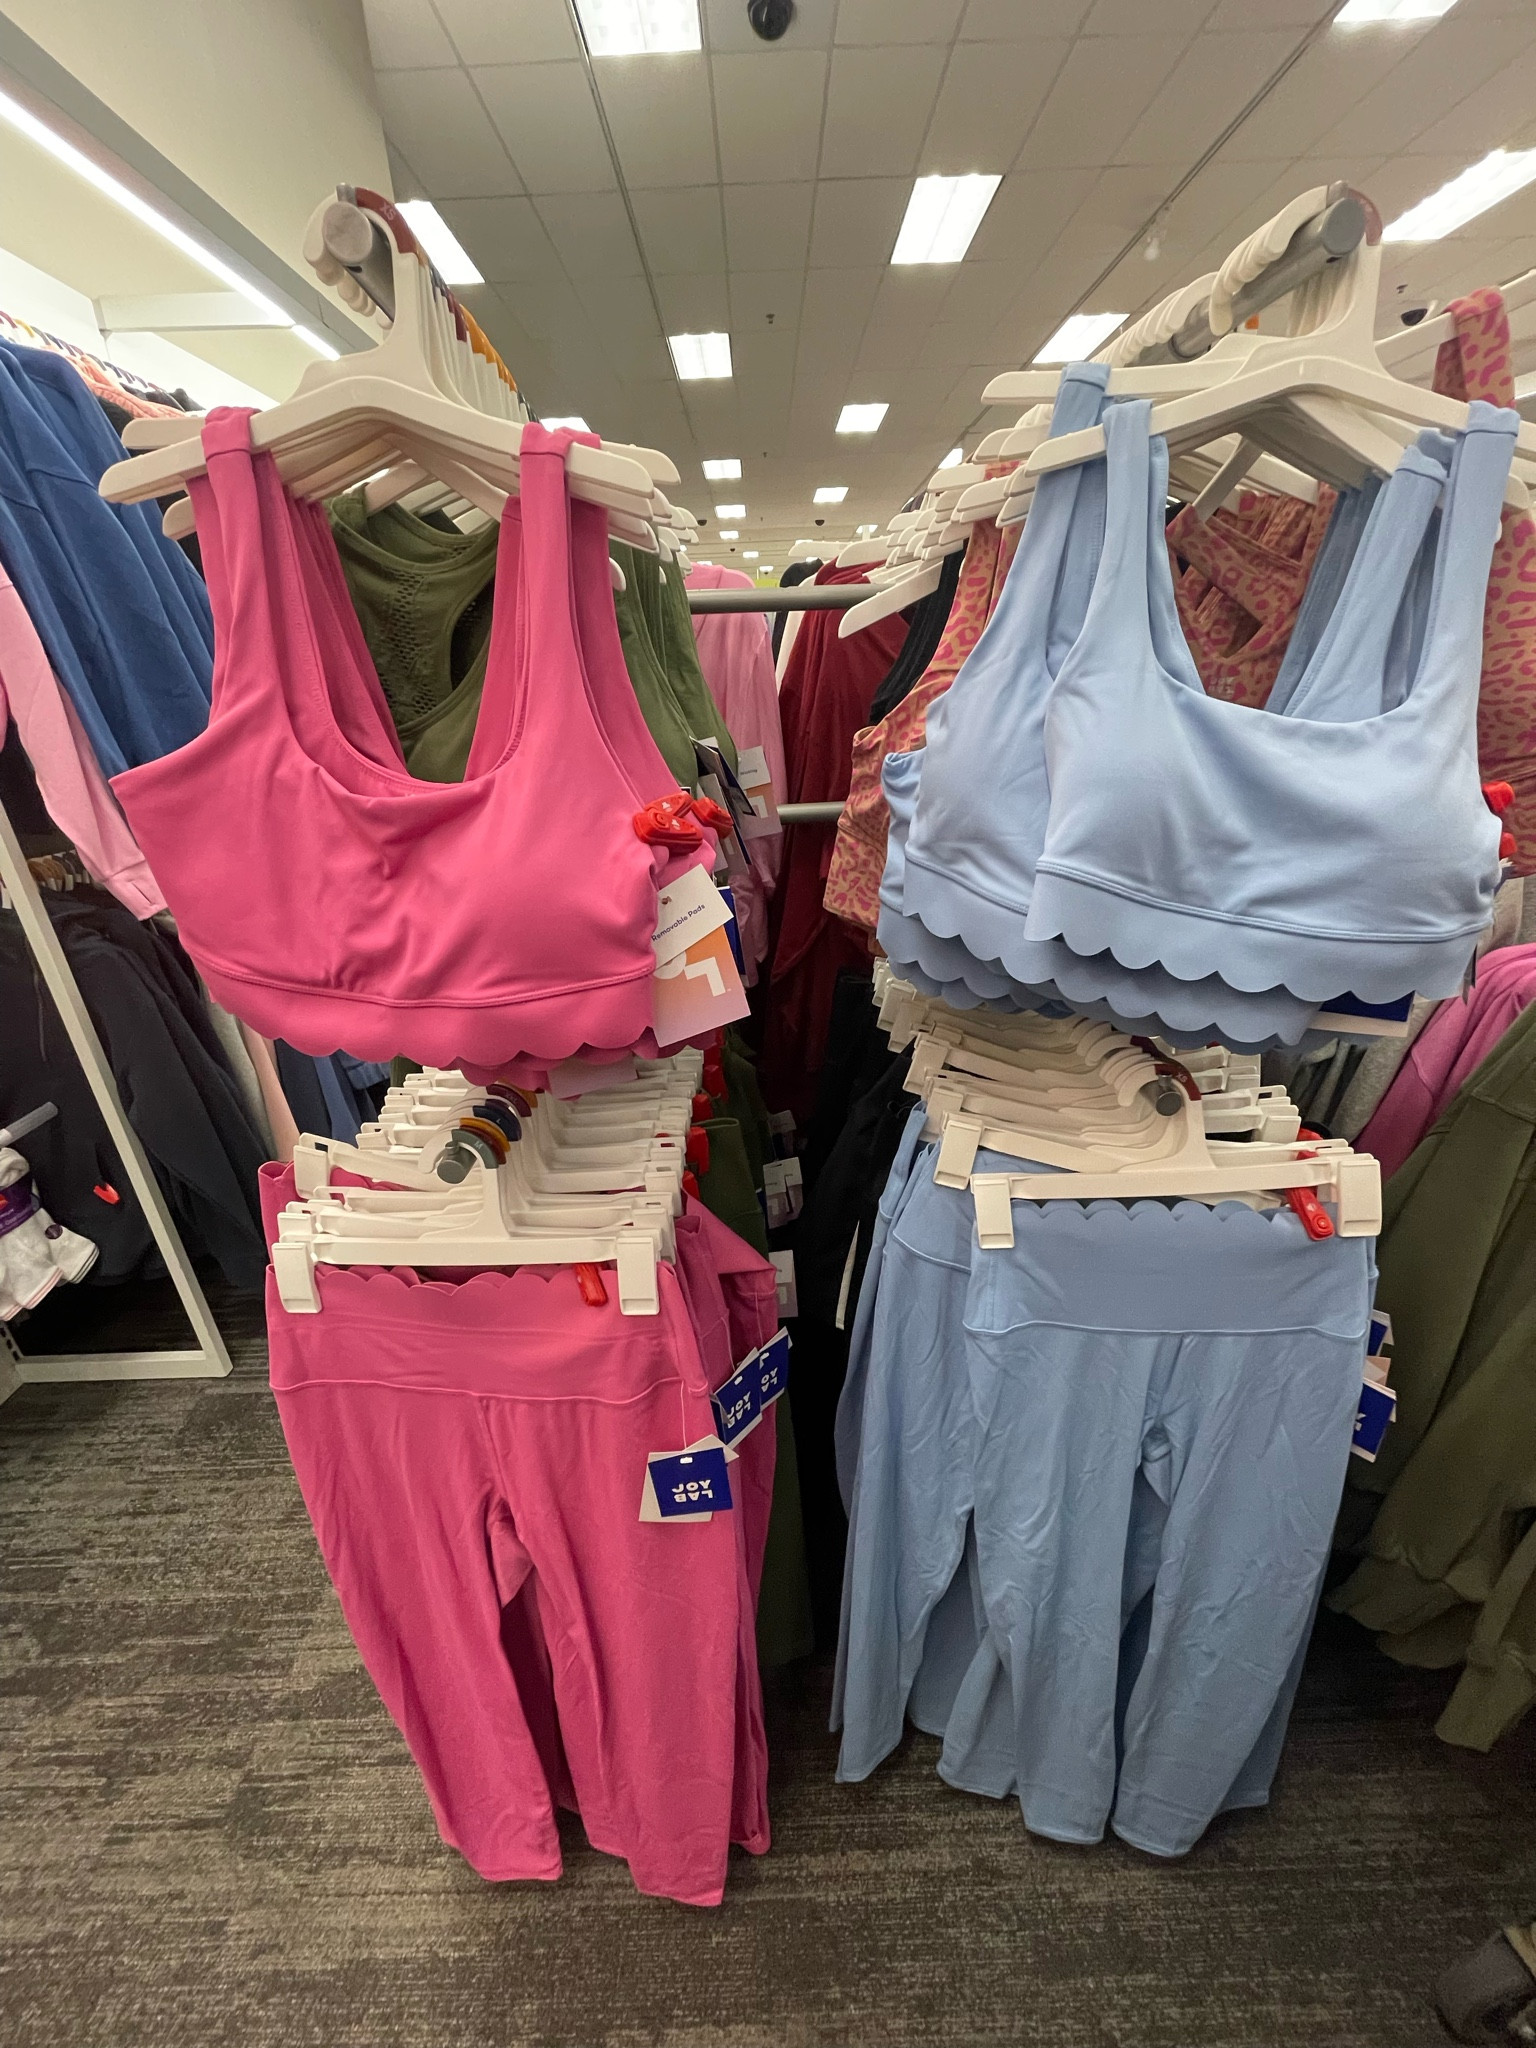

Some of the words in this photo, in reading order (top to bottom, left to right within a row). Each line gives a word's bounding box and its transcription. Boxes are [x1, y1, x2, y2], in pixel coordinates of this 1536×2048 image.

[380, 201, 396, 220] XS
[651, 916, 688, 942] Removable
[687, 903, 706, 917] Pads
[1175, 1071, 1188, 1083] XS
[474, 1140, 484, 1150] M
[761, 1367, 778, 1384] OY
[727, 1391, 751, 1418] JOY
[671, 1479, 711, 1493] JOY
